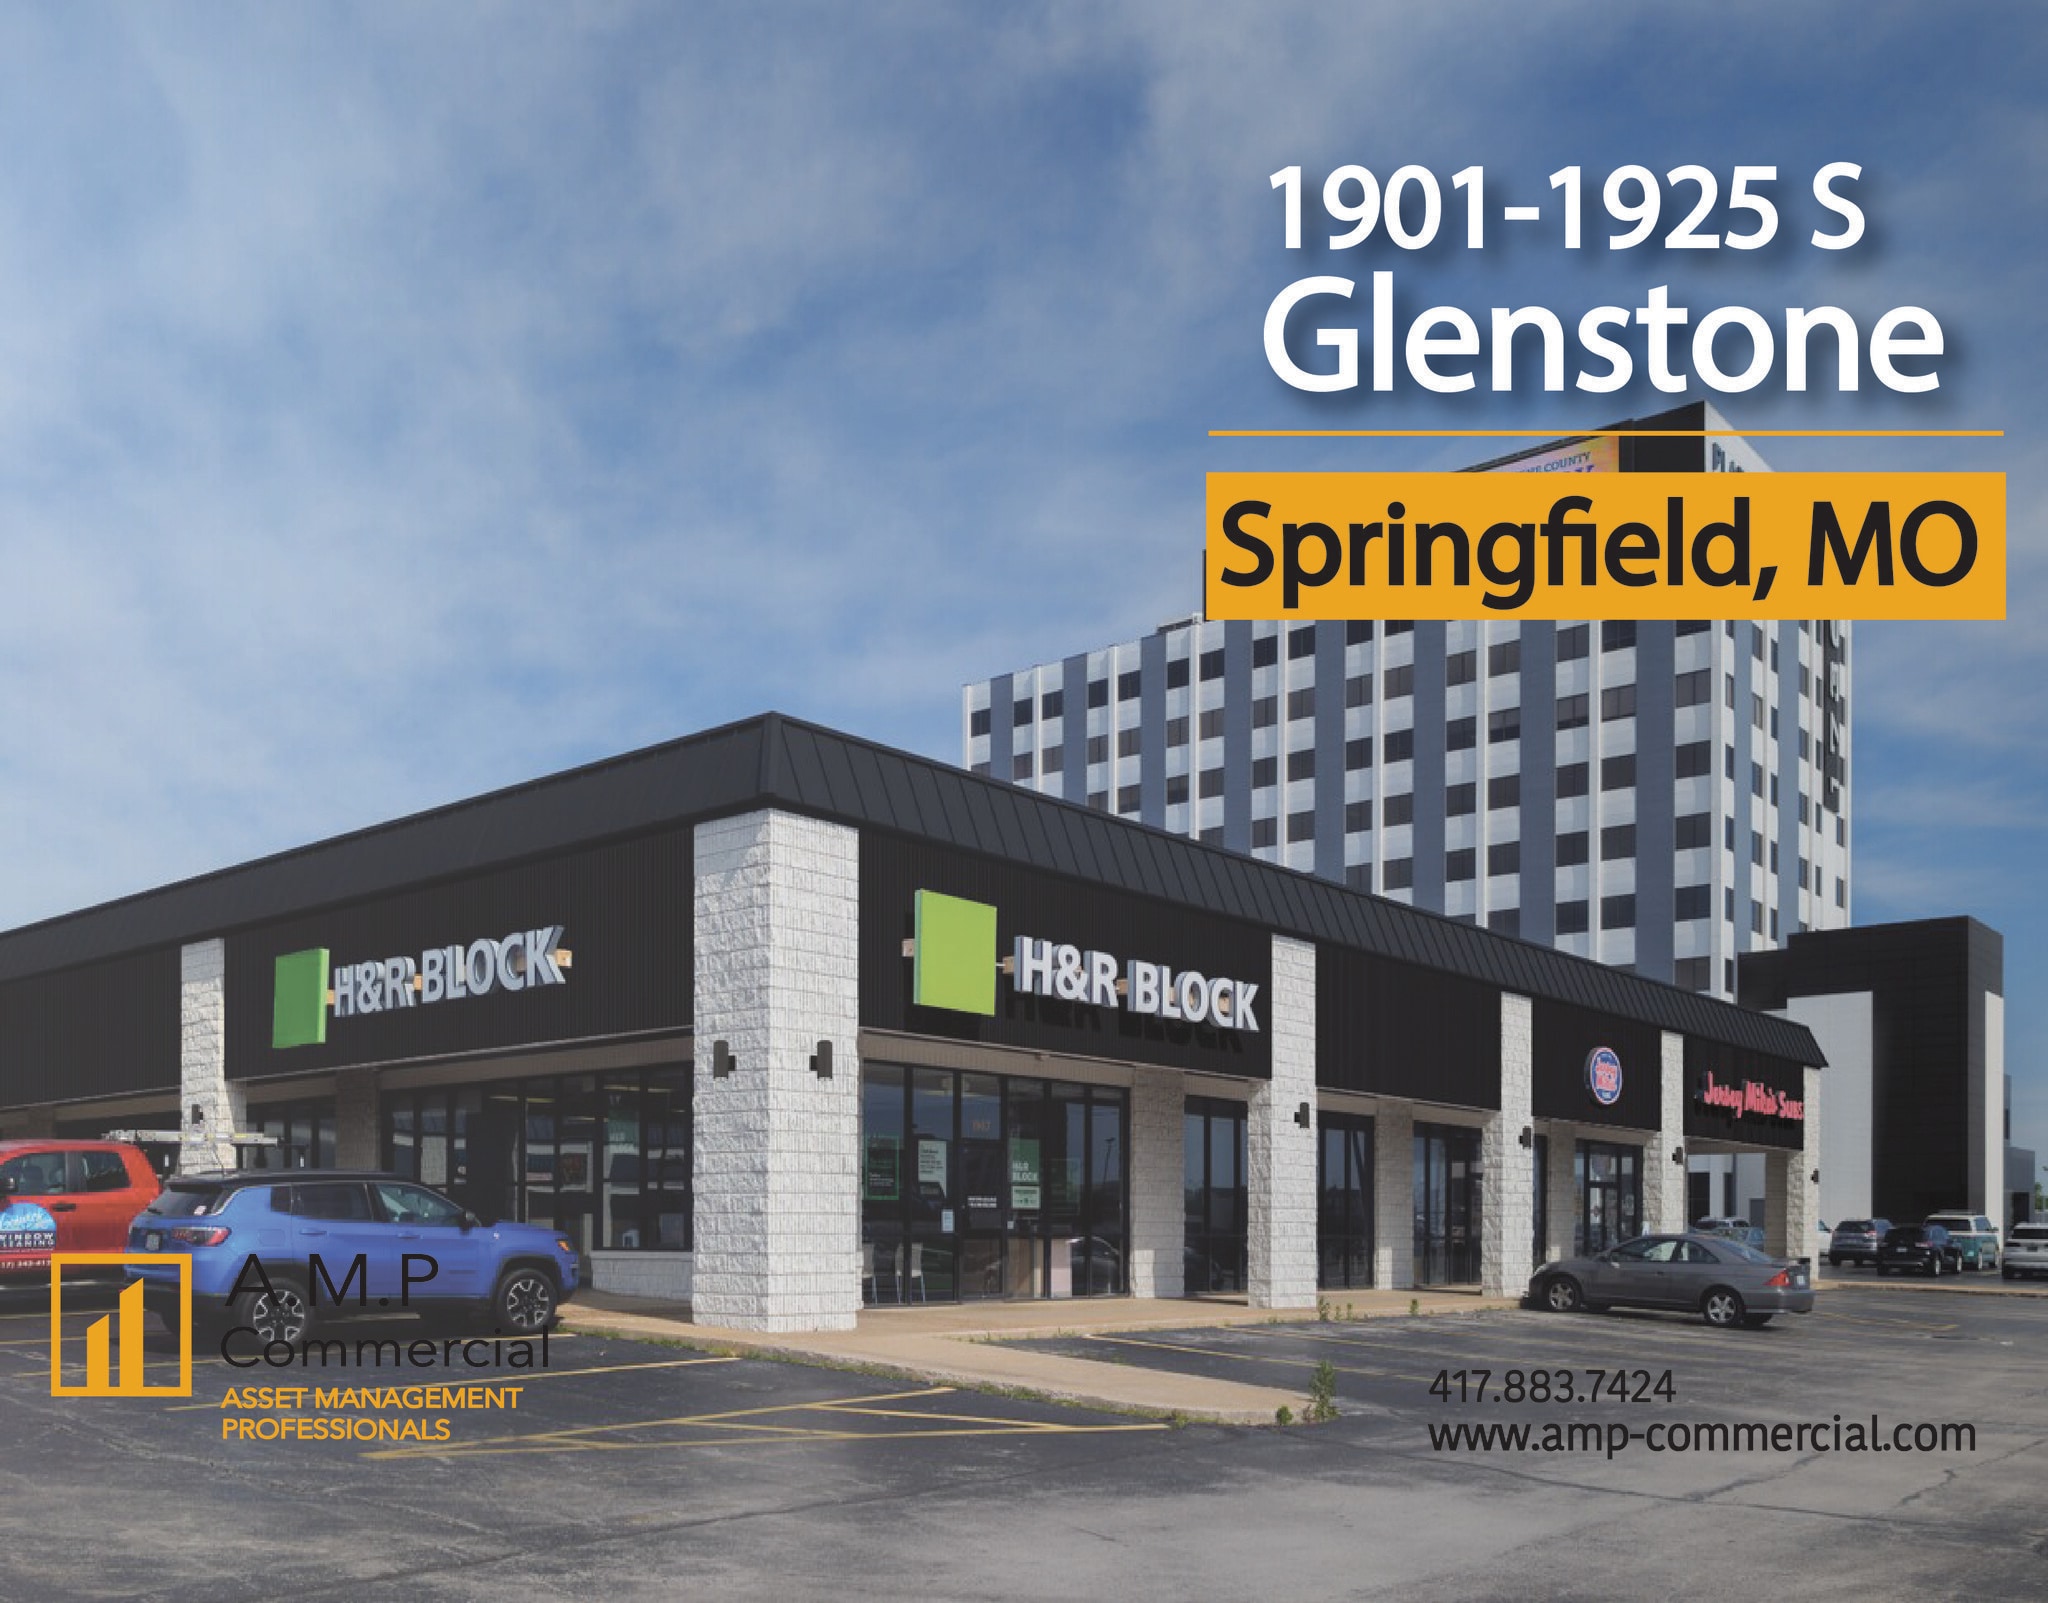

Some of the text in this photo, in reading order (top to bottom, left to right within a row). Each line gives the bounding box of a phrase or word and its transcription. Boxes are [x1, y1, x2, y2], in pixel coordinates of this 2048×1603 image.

[334, 925, 567, 1018] H&R BLOCK
[1013, 935, 1259, 1031] H&R BLOCK
